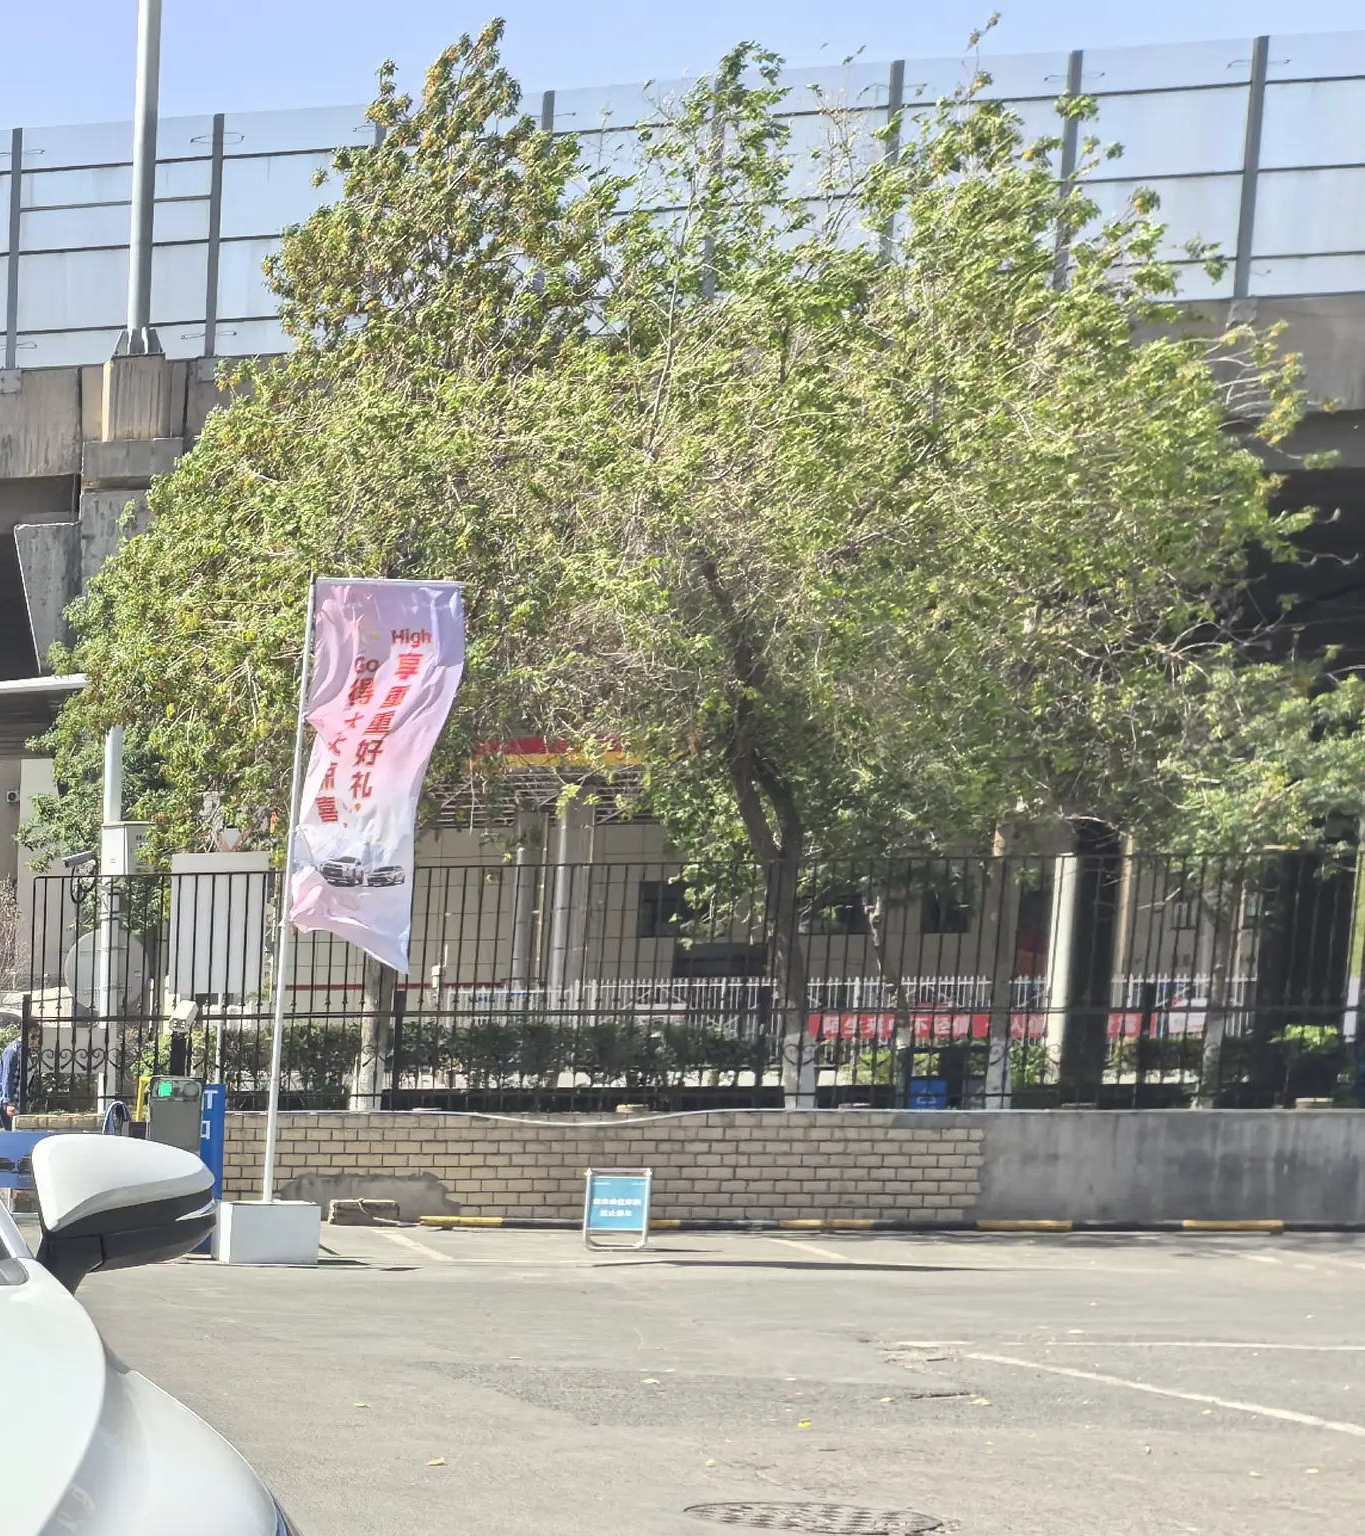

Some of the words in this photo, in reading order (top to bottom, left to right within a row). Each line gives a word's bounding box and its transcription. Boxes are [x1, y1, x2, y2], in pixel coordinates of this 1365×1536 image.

[391, 628, 432, 648] High
[355, 656, 379, 673] Go
[350, 653, 424, 799] 享重重好礼
